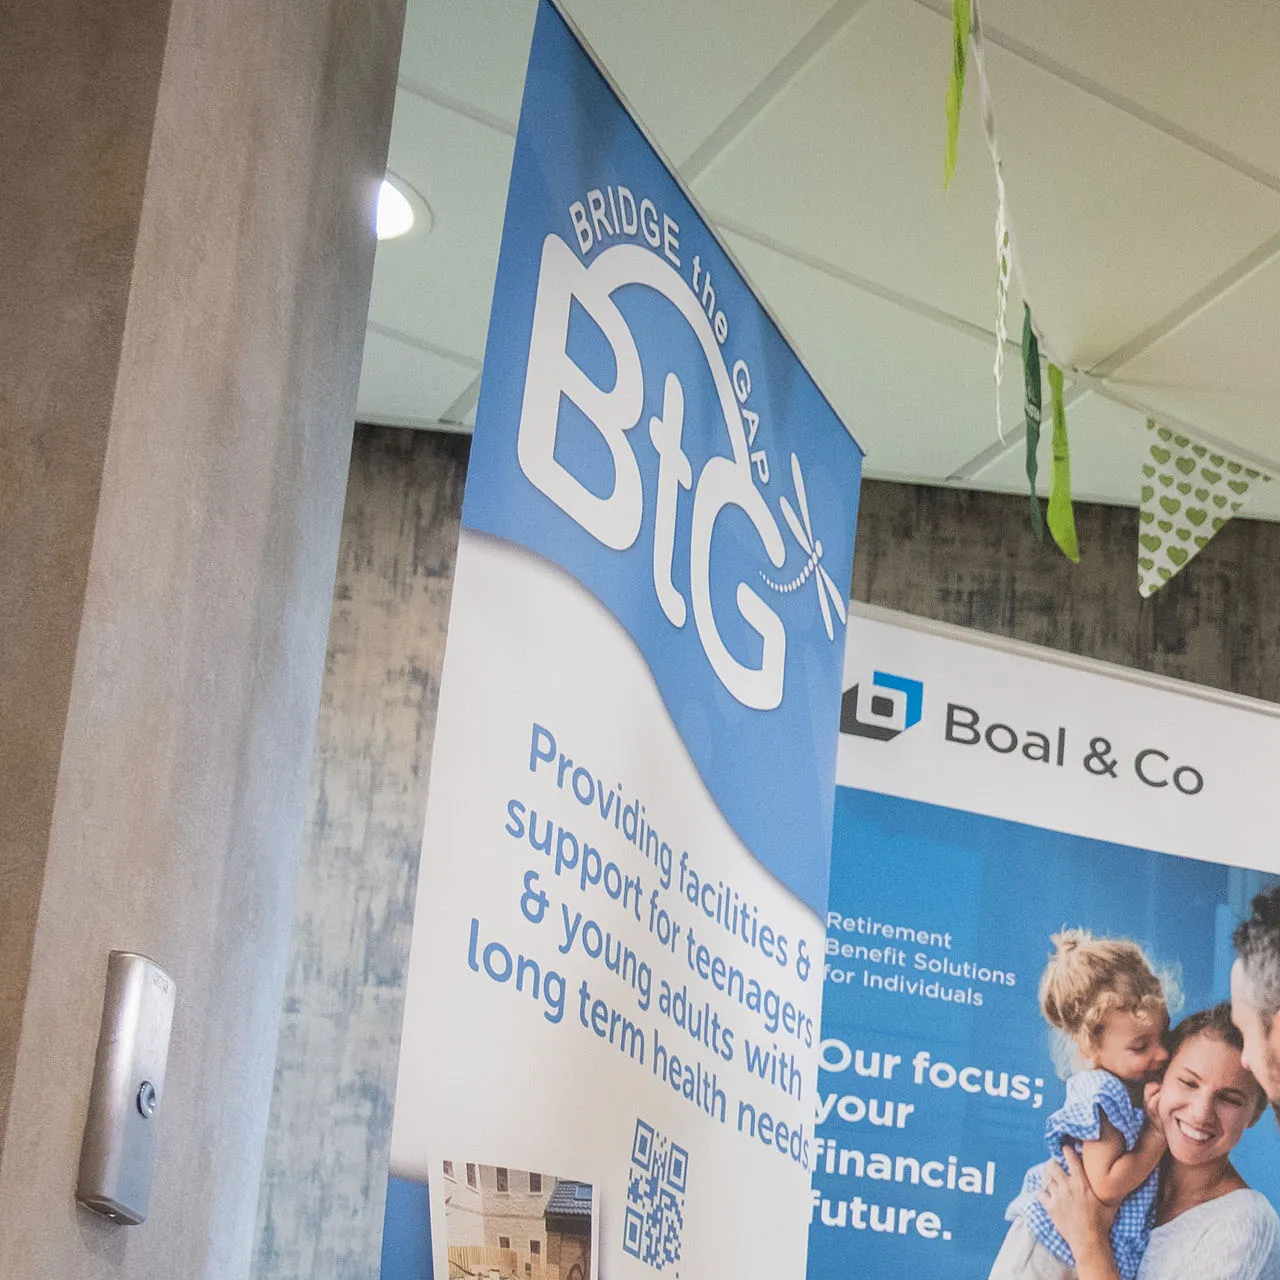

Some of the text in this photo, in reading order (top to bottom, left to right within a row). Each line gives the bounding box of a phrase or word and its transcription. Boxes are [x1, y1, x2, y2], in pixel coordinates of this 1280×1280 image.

[568, 183, 770, 485] BRIDGE the GAP
[517, 233, 786, 711] BtG
[944, 702, 1205, 796] Boal & Co
[529, 722, 811, 983] Providing facilities &
[504, 798, 814, 1050] support for teenagers
[825, 937, 1017, 986] Benefit Solutions
[826, 911, 952, 950] Retirement
[520, 869, 802, 1102] & young adults with
[823, 964, 984, 1007] for Individuals
[467, 916, 812, 1174] long term health needs.
[817, 1038, 1045, 1109] Our focus;
[813, 1091, 915, 1130] your
[811, 1138, 996, 1196] financial
[808, 1189, 952, 1241] future.
